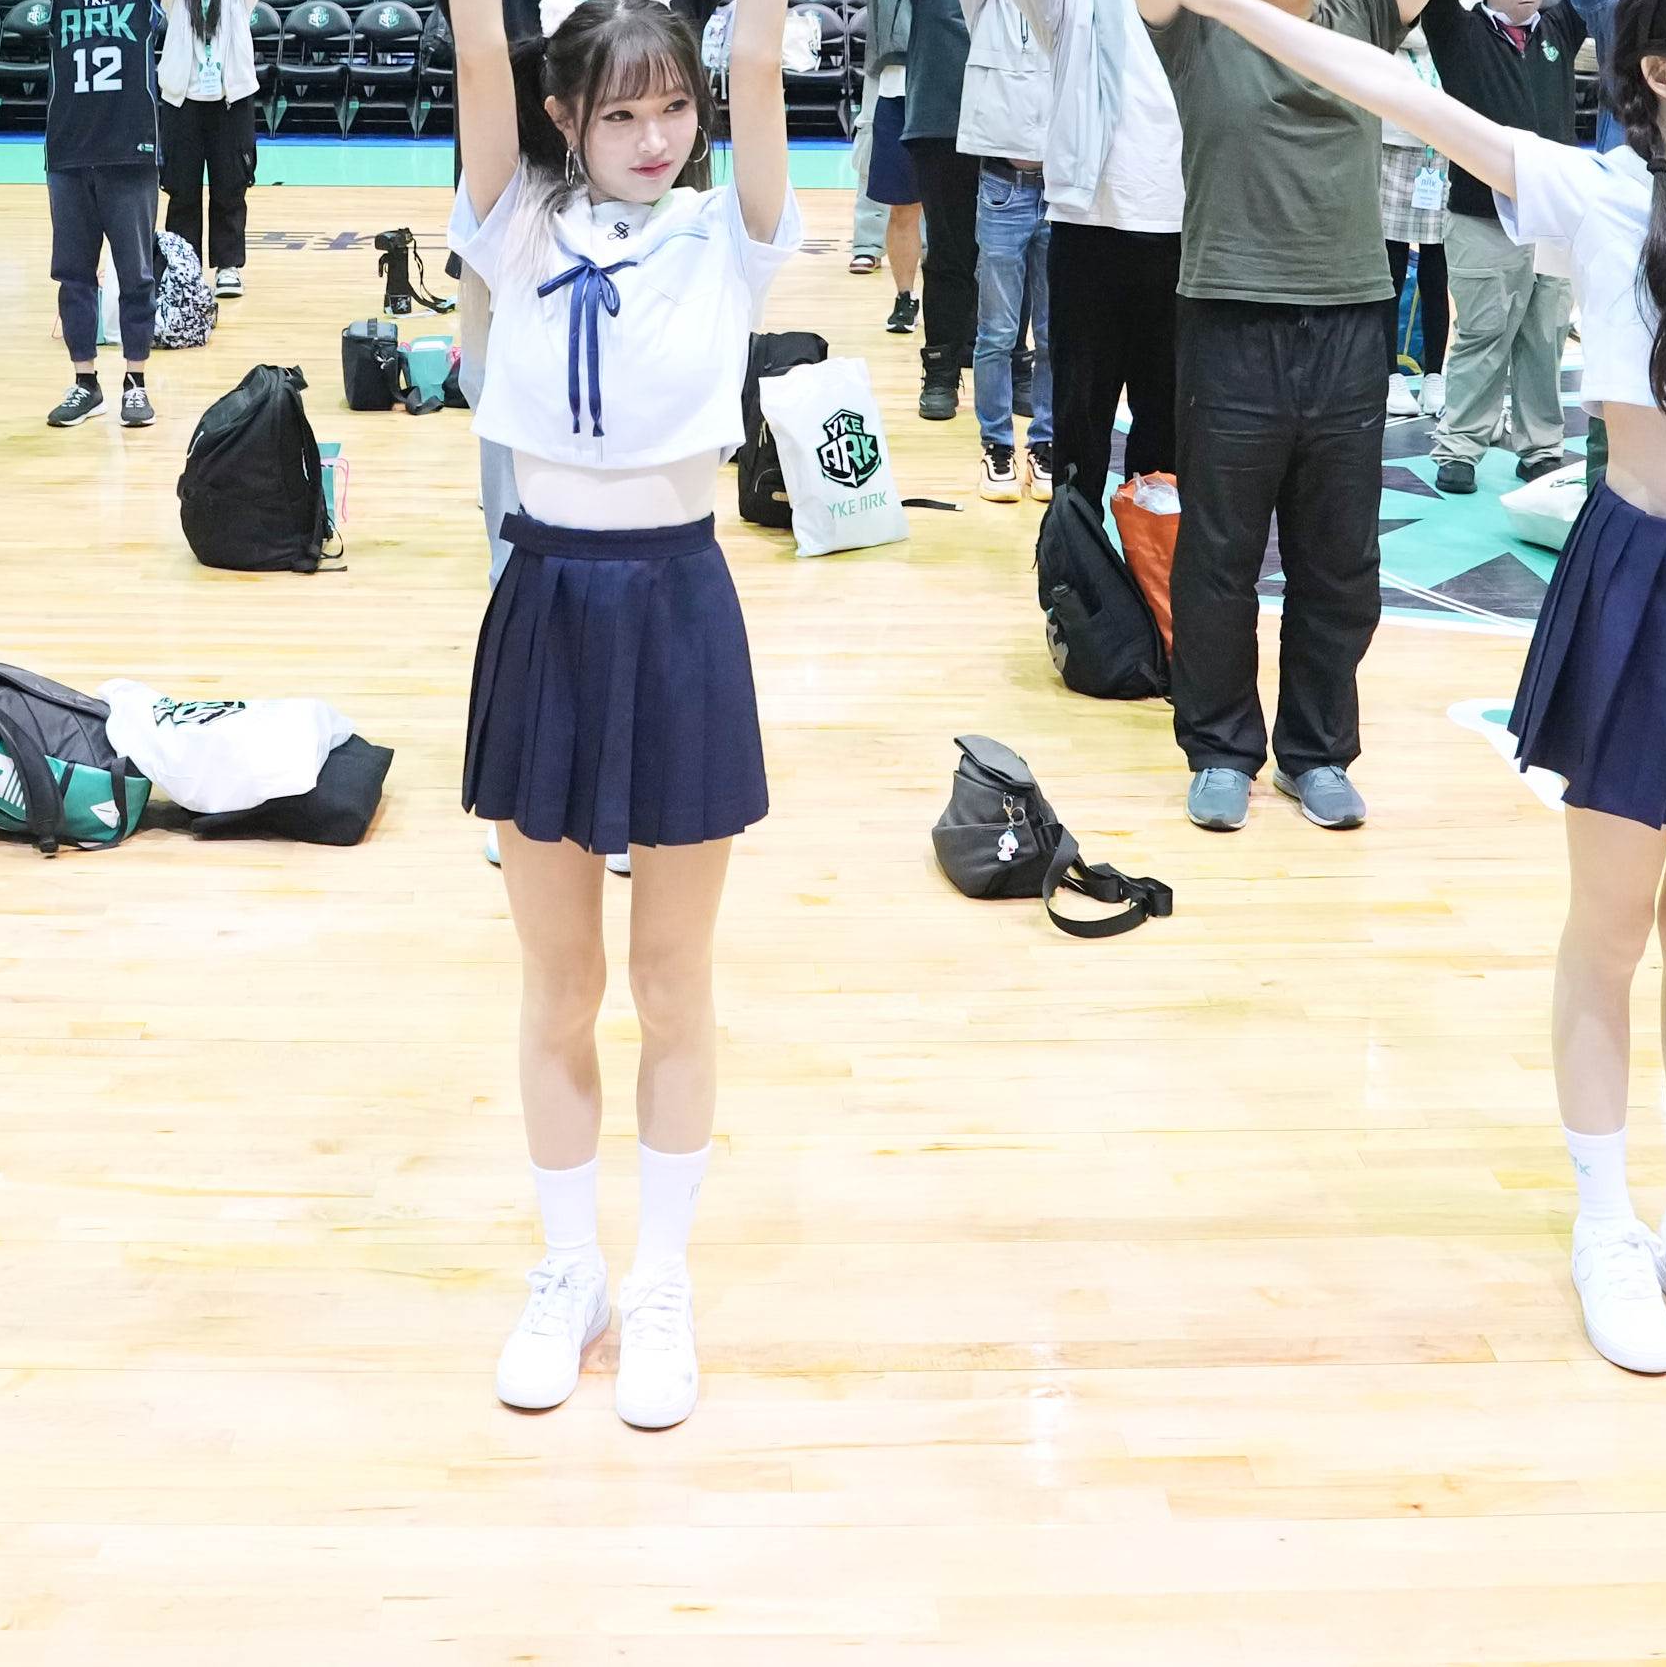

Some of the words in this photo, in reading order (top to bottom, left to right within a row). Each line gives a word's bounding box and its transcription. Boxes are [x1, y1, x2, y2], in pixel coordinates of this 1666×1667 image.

[60, 2, 138, 49] ARK
[73, 45, 123, 94] 12
[826, 415, 863, 439] YKE
[820, 433, 878, 474] ARK
[827, 498, 856, 520] YKE
[859, 490, 888, 511] ARK
